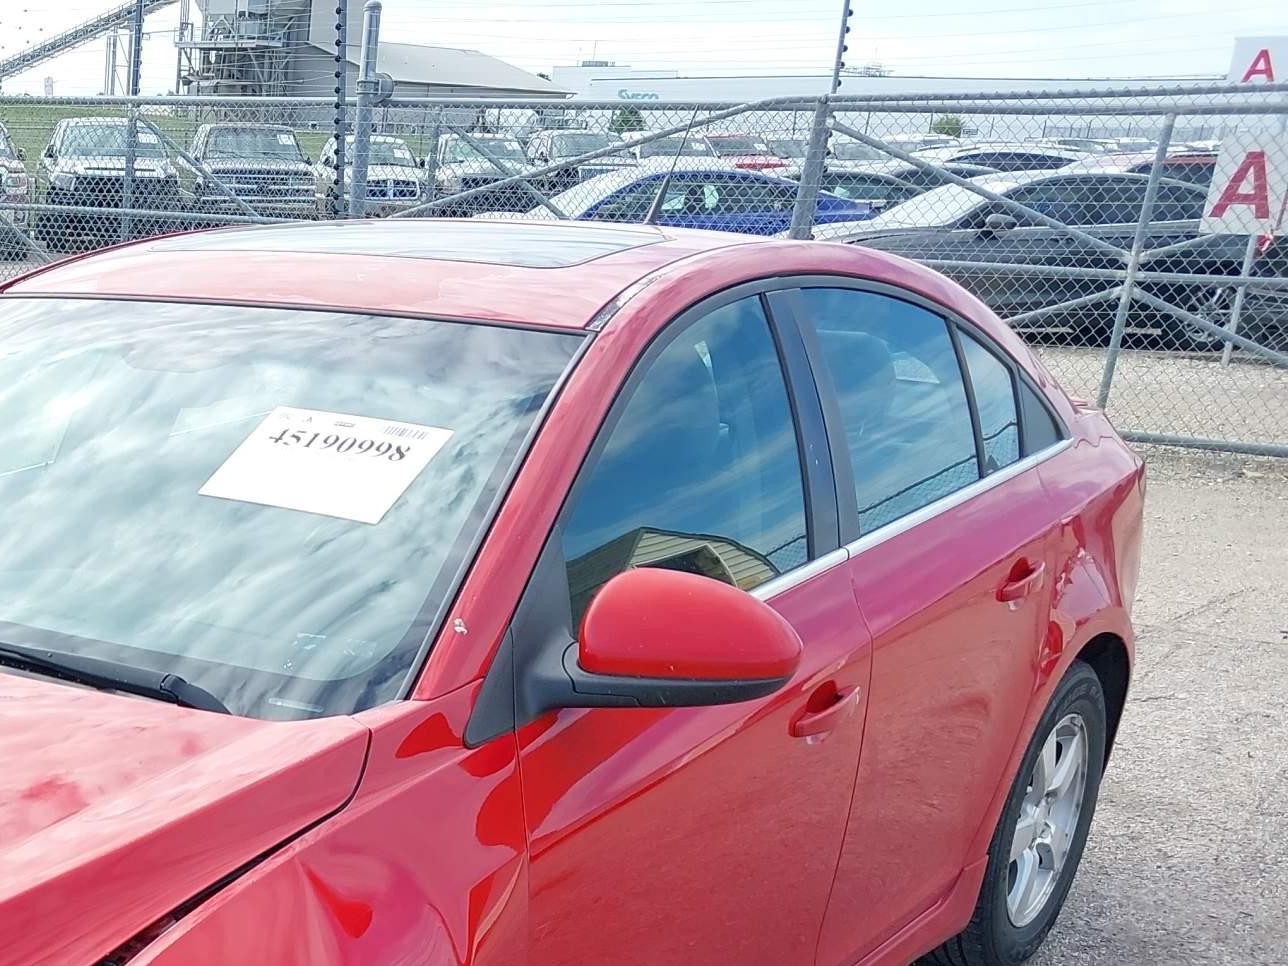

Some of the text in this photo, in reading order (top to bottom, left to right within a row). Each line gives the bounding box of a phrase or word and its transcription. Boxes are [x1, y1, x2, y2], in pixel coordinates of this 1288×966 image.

[1241, 48, 1274, 83] A
[1208, 152, 1270, 219] A
[268, 428, 411, 462] 45190998
